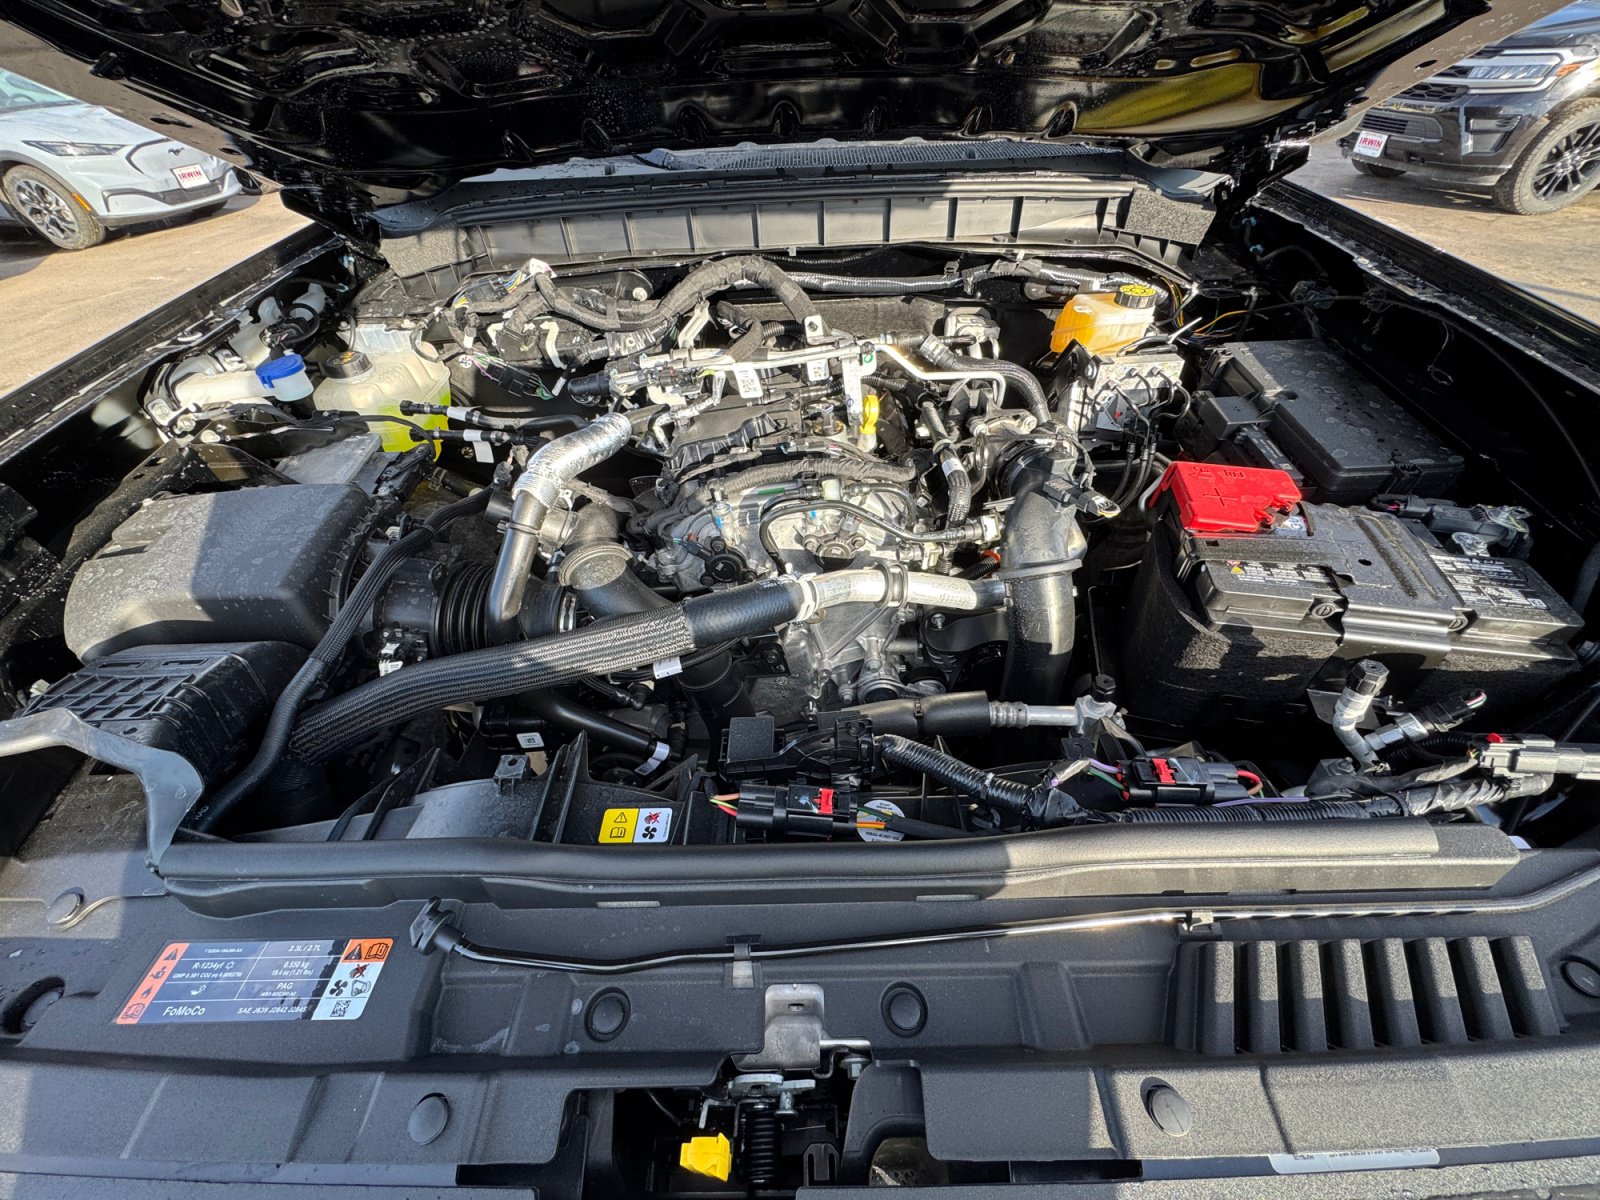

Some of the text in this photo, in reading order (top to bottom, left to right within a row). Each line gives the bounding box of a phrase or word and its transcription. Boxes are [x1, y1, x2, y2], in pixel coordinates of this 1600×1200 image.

[1359, 137, 1382, 149] IRWIN
[178, 170, 201, 180] IRWIN
[192, 961, 225, 970] R-1234yf
[301, 960, 310, 969] kg
[162, 1006, 206, 1017] FoMoCo
